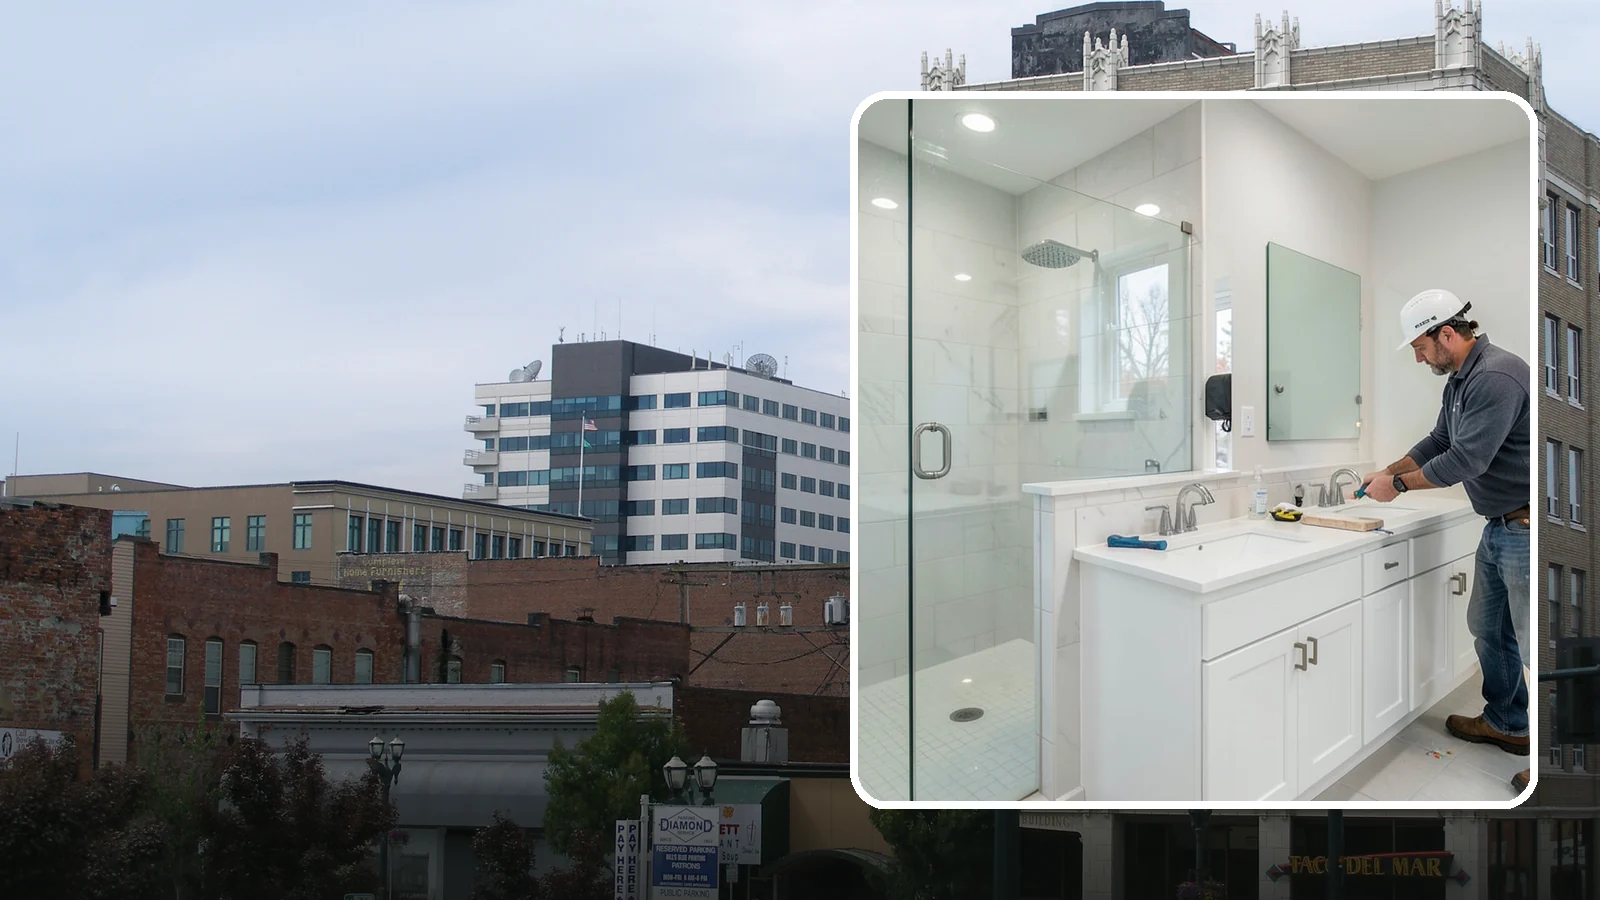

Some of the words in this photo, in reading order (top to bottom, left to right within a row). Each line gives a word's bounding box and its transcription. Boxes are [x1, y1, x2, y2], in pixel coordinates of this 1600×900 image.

[343, 568, 368, 577] Home
[370, 566, 427, 576] Furnishers
[660, 818, 713, 832] DIAMOND
[1022, 815, 1070, 828] BUILDING
[617, 824, 625, 852] PAY
[628, 824, 636, 852] PAY
[722, 852, 739, 862] Soup
[616, 856, 625, 893] HERE
[628, 856, 636, 893] HERE
[1346, 856, 1386, 875] DEL
[1392, 858, 1442, 876] MAR
[684, 890, 710, 898] PARKING
